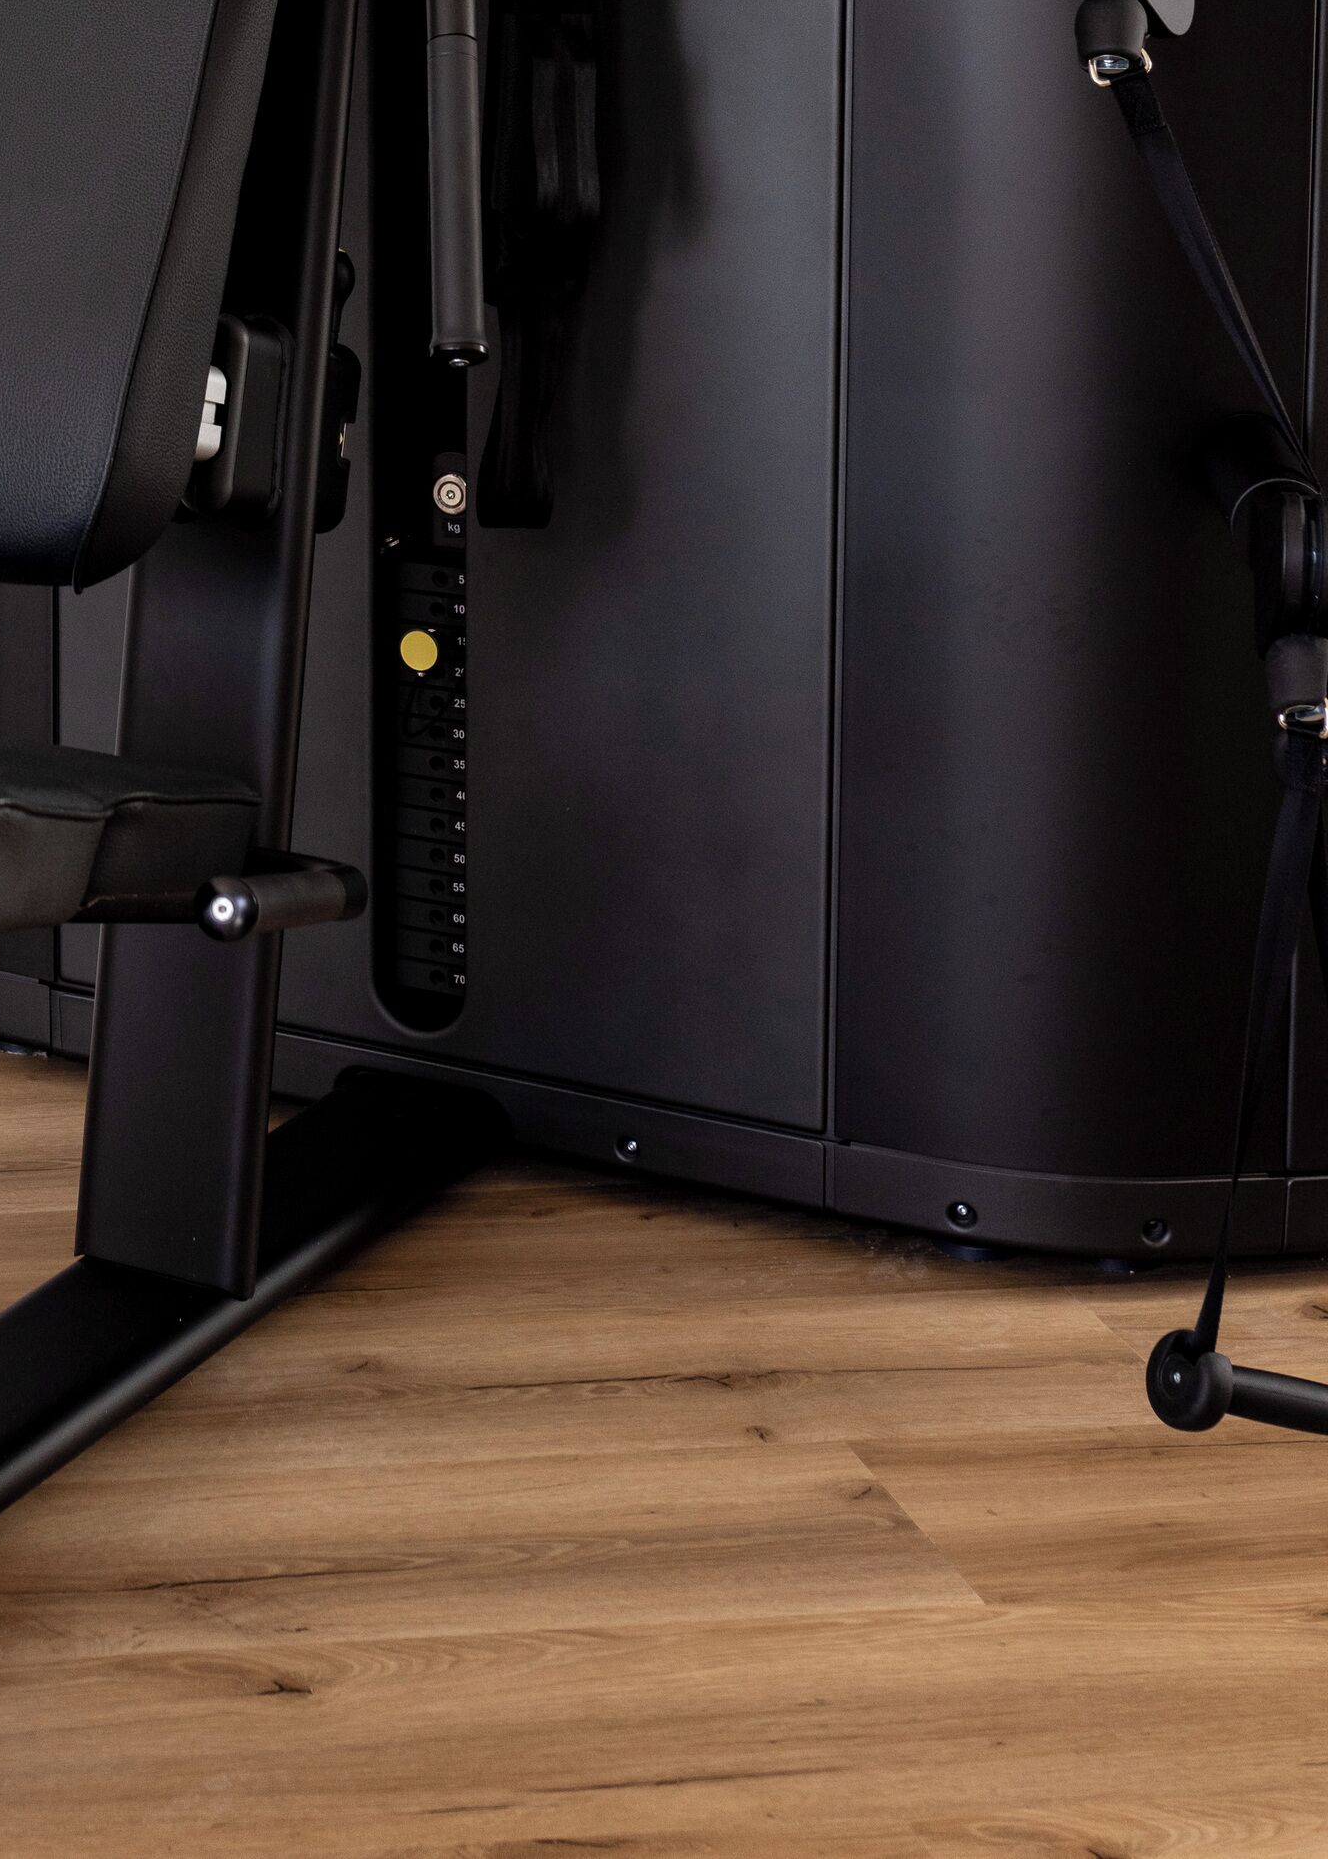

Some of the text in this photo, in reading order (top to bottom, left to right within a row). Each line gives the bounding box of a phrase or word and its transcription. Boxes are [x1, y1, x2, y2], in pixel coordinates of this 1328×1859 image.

[447, 522, 461, 534] kg
[458, 575, 465, 585] 5
[453, 605, 465, 614] 10
[454, 698, 465, 709] 25
[453, 729, 465, 739] 30
[453, 759, 465, 770] 35
[454, 854, 465, 864] 50
[453, 882, 465, 892] 55
[453, 913, 465, 924] 60
[452, 943, 465, 953] 65
[454, 974, 465, 984] 70
